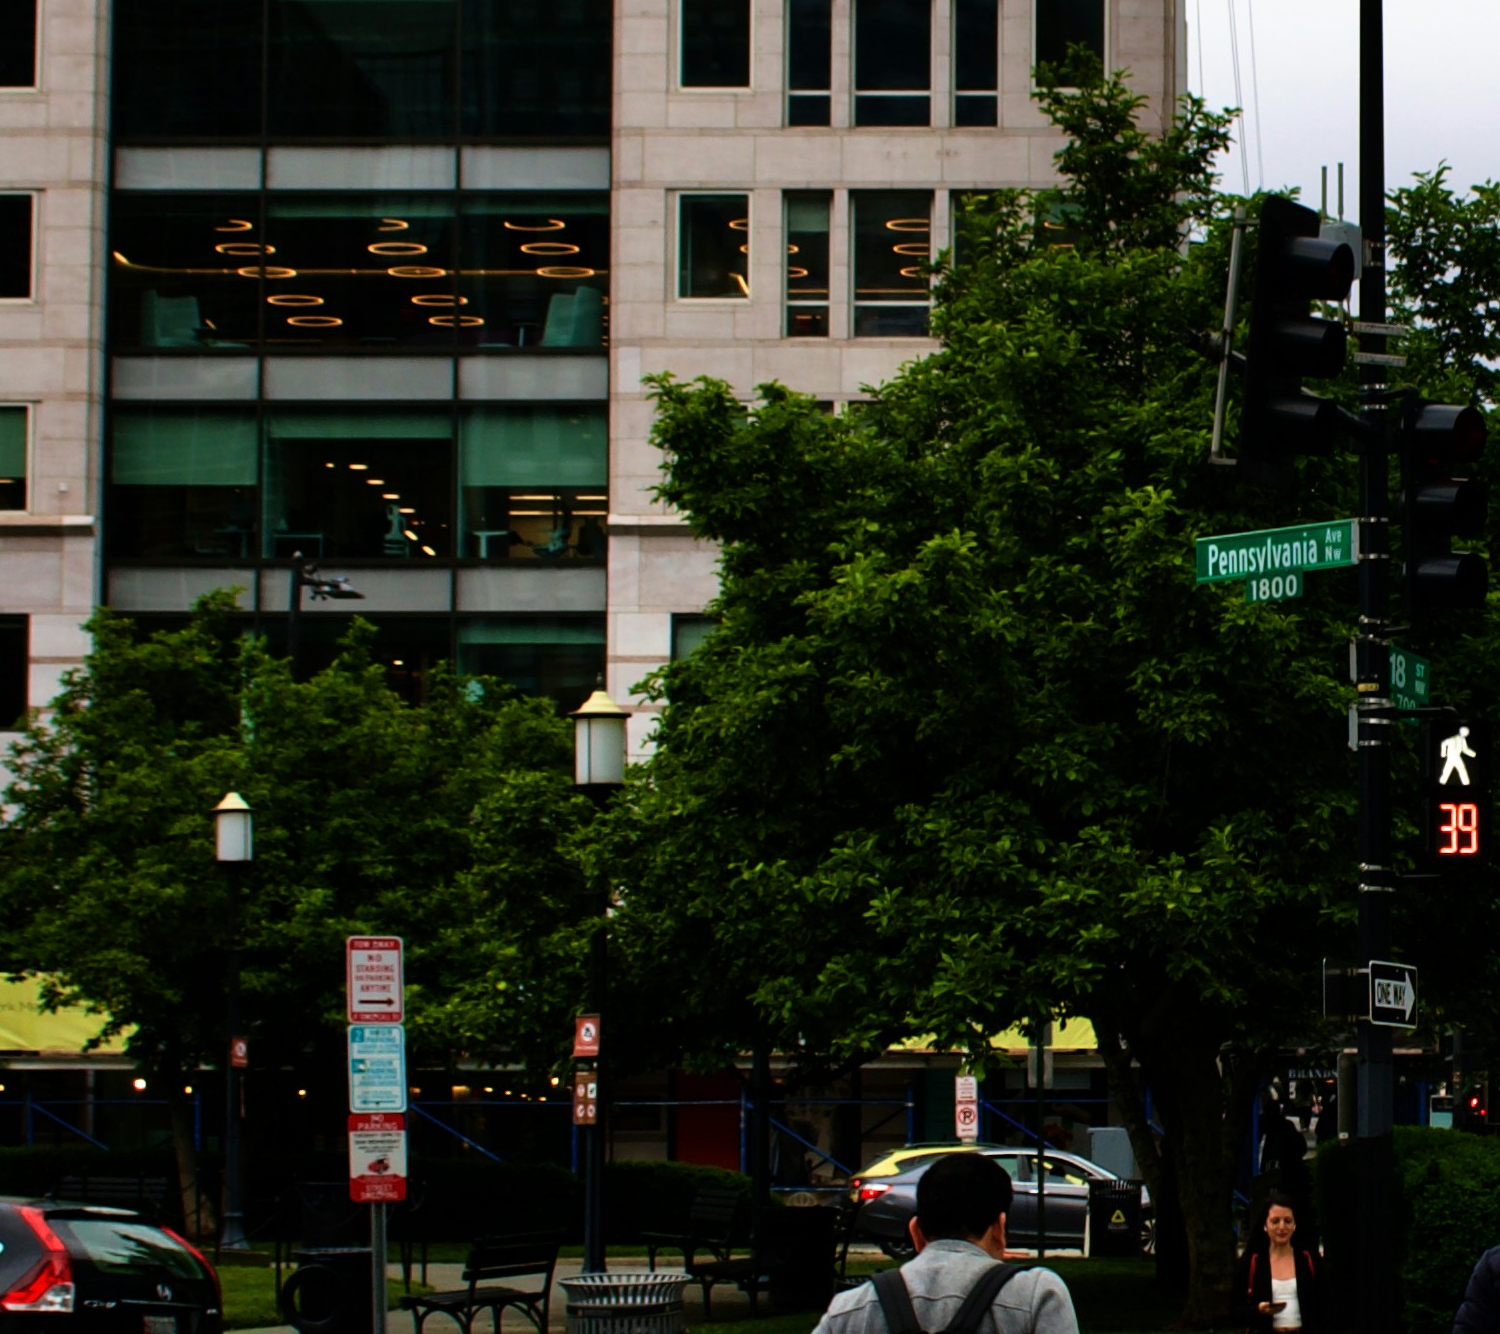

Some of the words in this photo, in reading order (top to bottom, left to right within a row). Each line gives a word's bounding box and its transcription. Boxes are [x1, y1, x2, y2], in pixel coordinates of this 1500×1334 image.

[1208, 532, 1318, 576] Pennsylvania
[1325, 527, 1342, 543] Ave
[1251, 574, 1298, 601] 1800
[1389, 652, 1406, 689] 18
[1439, 803, 1478, 855] 39
[368, 954, 382, 962] NO
[1377, 981, 1392, 1005] ONE
[357, 1122, 399, 1131] PARKING
